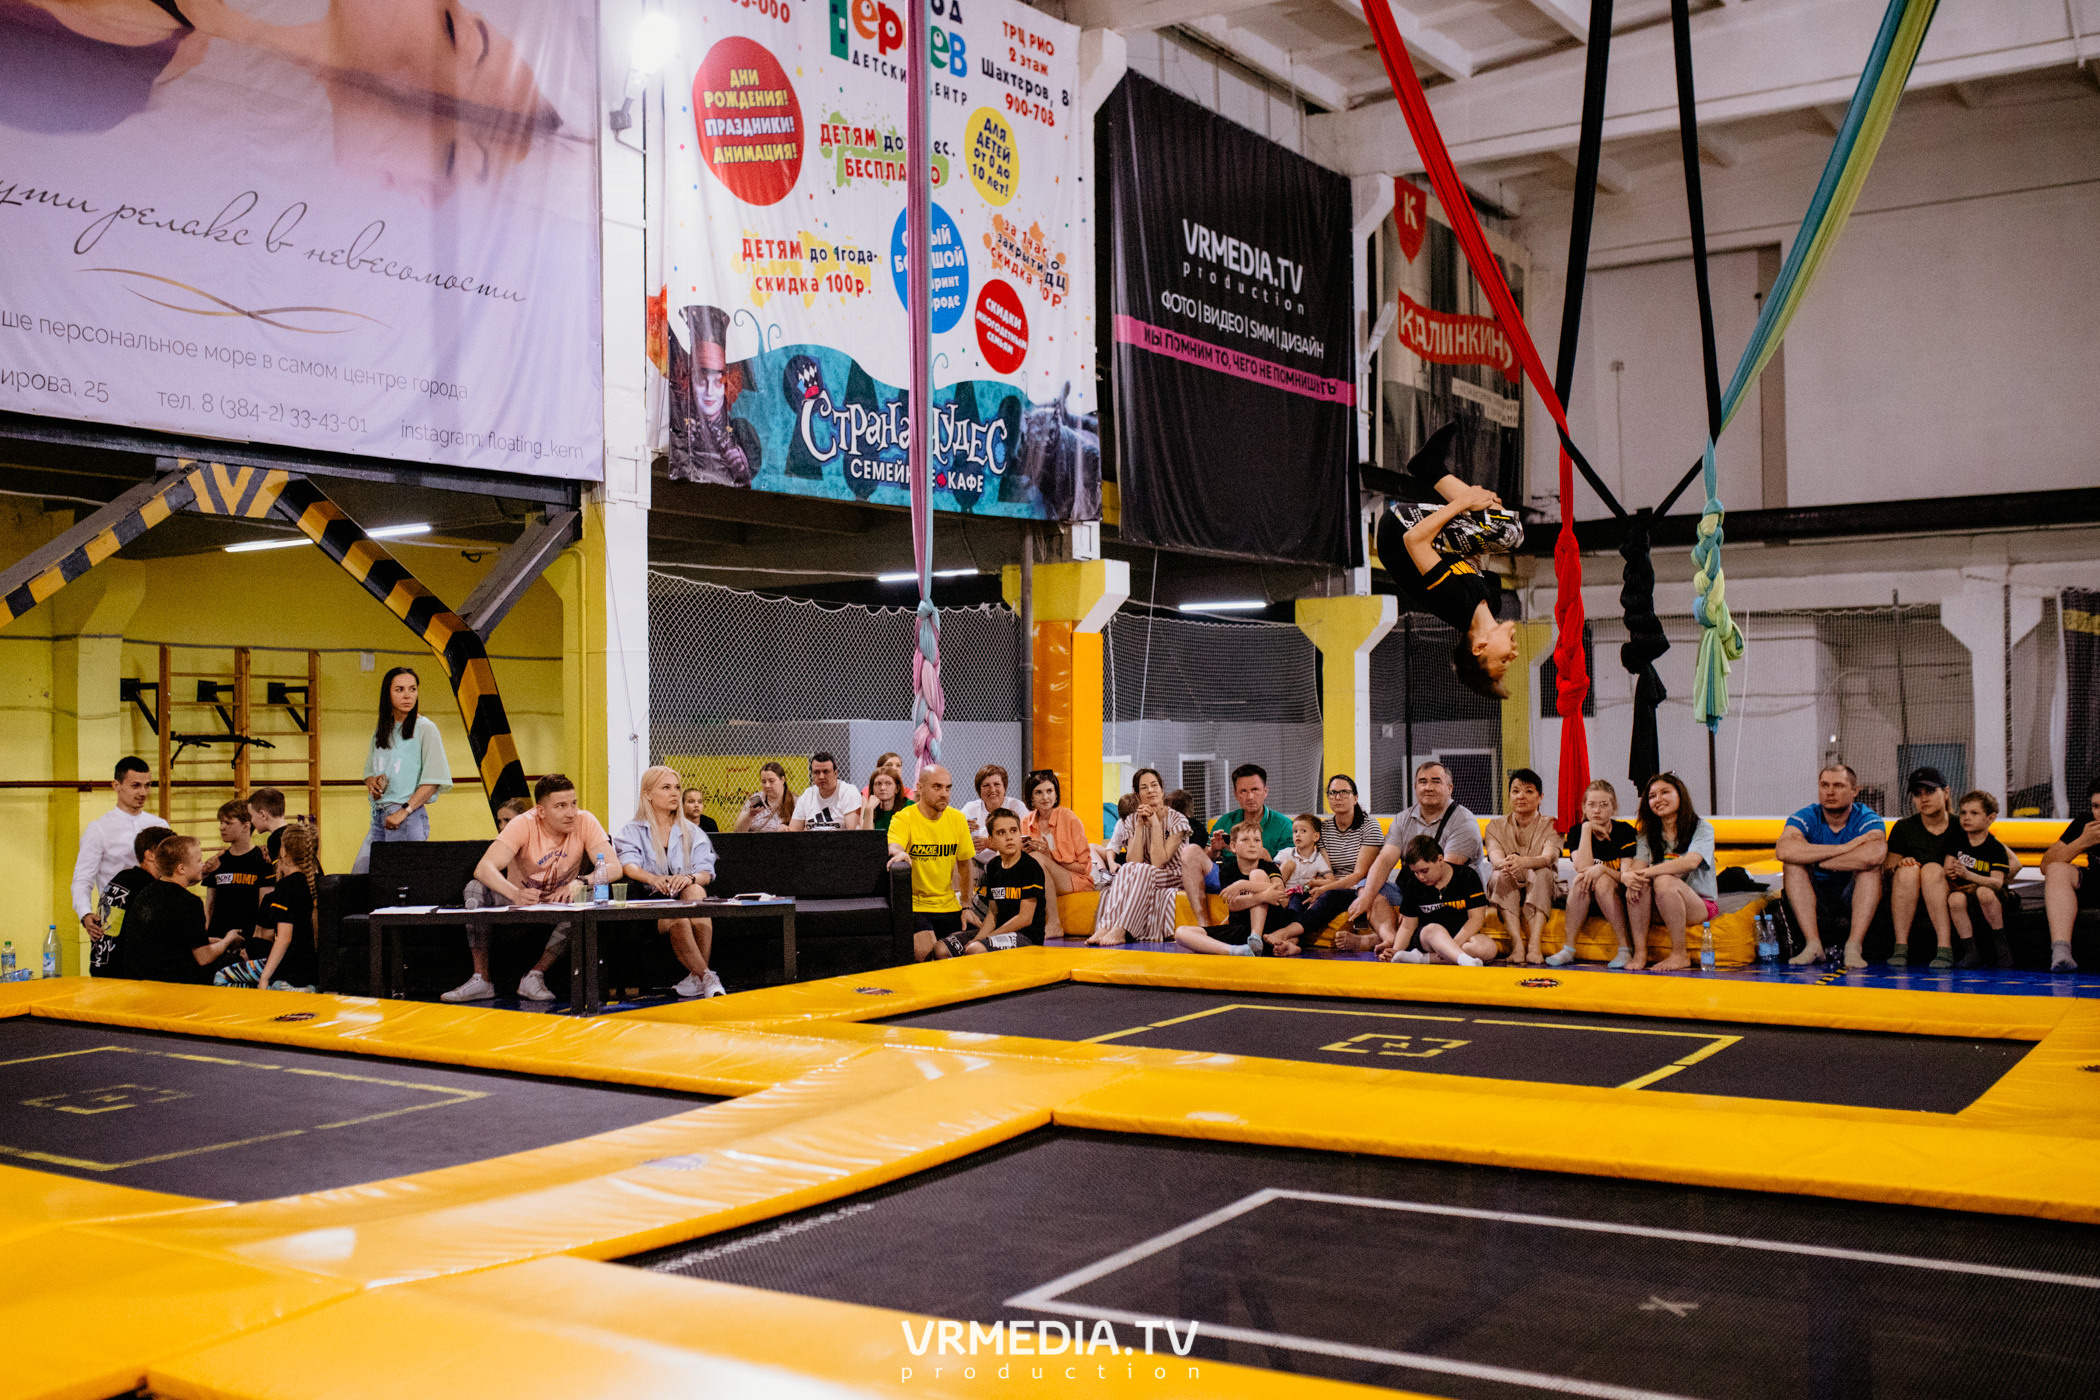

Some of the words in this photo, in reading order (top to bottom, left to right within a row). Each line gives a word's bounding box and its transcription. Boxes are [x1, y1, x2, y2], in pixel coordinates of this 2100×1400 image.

[731, 0, 790, 23] -000
[1003, 20, 1025, 48] ТРЦ
[1029, 34, 1054, 57] РИО
[1009, 47, 1016, 62] 2
[1020, 55, 1049, 76] этаж
[730, 69, 759, 88] ДНИ
[852, 50, 906, 84] ДЕТСКИ
[931, 82, 967, 106] ЕНТР
[981, 57, 1053, 107] Шахтеров,
[1062, 89, 1070, 106] 8
[703, 89, 789, 110] РОЖДЕНИЯ!
[704, 115, 796, 138] ПРАЗДНИКИ!
[820, 123, 877, 147] ДЕТЯМ
[884, 135, 904, 154] до
[984, 117, 1006, 142] ДЛЯ
[713, 142, 797, 164] АНИМАЦИЯ!
[976, 131, 1011, 164] ДЕТЕЙ
[844, 156, 940, 185] БЕСПЛАО
[973, 147, 987, 162] от
[988, 151, 995, 167] 0
[996, 164, 1010, 180] до
[972, 163, 985, 180] 10
[987, 172, 1009, 197] лет!
[1004, 220, 1017, 237] за
[73, 190, 259, 255] релакс
[265, 201, 308, 253] в
[303, 220, 527, 302] невесомости
[742, 238, 804, 262] ДЕТЯМ
[810, 248, 828, 263] до
[997, 233, 1044, 273] закрыти
[1182, 218, 1303, 295] VRMEDIA.TV
[991, 246, 1033, 286] скидка
[755, 276, 820, 295] скидка
[826, 273, 872, 298] 100р.
[1183, 261, 1304, 315] production
[985, 297, 1022, 330] СКИДКИ
[1161, 290, 1197, 318] ФОТО
[1204, 304, 1244, 334] ВИДЕО
[1250, 322, 1275, 344] SMM
[1280, 331, 1324, 359] ДИЗАЙН
[975, 310, 1028, 350] МНОГОДЕТНЫМ
[986, 331, 1014, 355] СЕМЬЯМ
[1, 309, 33, 331] ше
[39, 317, 199, 358] персональное
[204, 345, 257, 369] море
[262, 353, 273, 369] в
[278, 356, 338, 380] самом
[343, 368, 407, 393] центре
[413, 377, 468, 401] города
[1215, 349, 1232, 370] ТО,
[1233, 353, 1257, 376] ЧЕГО
[1259, 365, 1272, 379] НЕ
[84, 379, 109, 403] 25
[157, 391, 196, 411] тел.
[202, 393, 214, 413] 8
[220, 394, 285, 423] (384-2)
[290, 407, 368, 433] 33-43-01
[401, 419, 485, 448] instagram:
[488, 430, 584, 460] floating_kem
[948, 471, 984, 493] КАФЕ
[939, 844, 958, 857] JUM
[232, 873, 258, 885] JUMP
